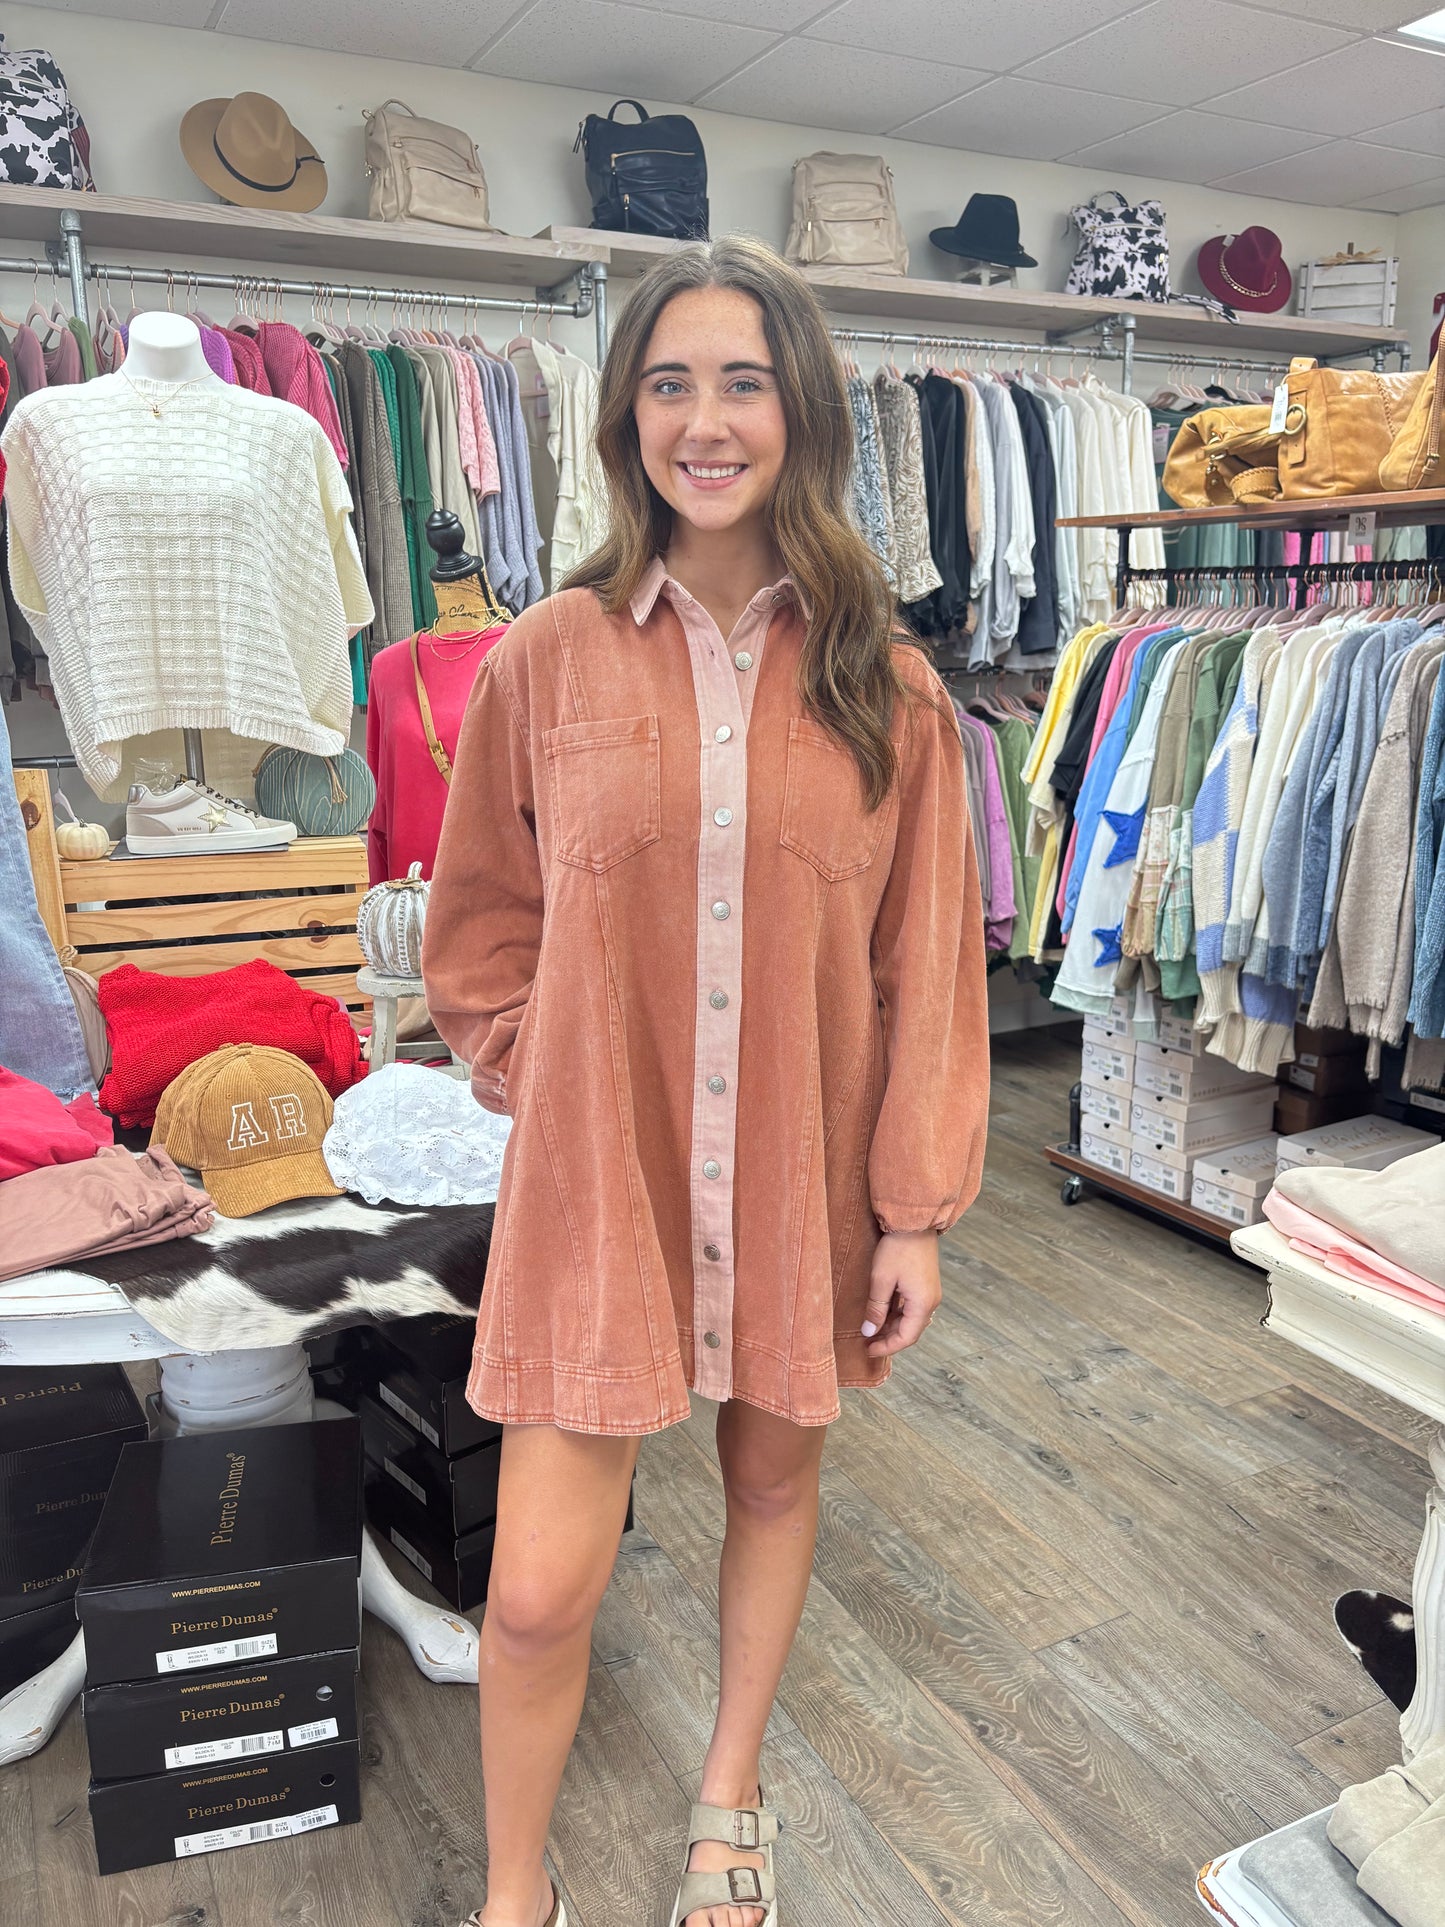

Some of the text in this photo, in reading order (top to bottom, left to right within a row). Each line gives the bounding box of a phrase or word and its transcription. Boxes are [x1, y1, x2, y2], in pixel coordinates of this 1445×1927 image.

[14, 1381, 83, 1401] Pierre
[36, 1498, 78, 1515] Pierre
[210, 1454, 246, 1546] Pierre Dumas
[22, 1574, 64, 1593] Pierre
[171, 1581, 261, 1598] WWW.PIERREDUMAS.COM
[171, 1611, 274, 1635] Pierre Dumas
[180, 1675, 268, 1694] WWW.PIERREDUMAS.COM
[180, 1697, 281, 1723] Pierre Dumas
[182, 1767, 268, 1788] WWW.PIERREDUMAS.COM
[187, 1791, 286, 1820] Pierre Dumas
